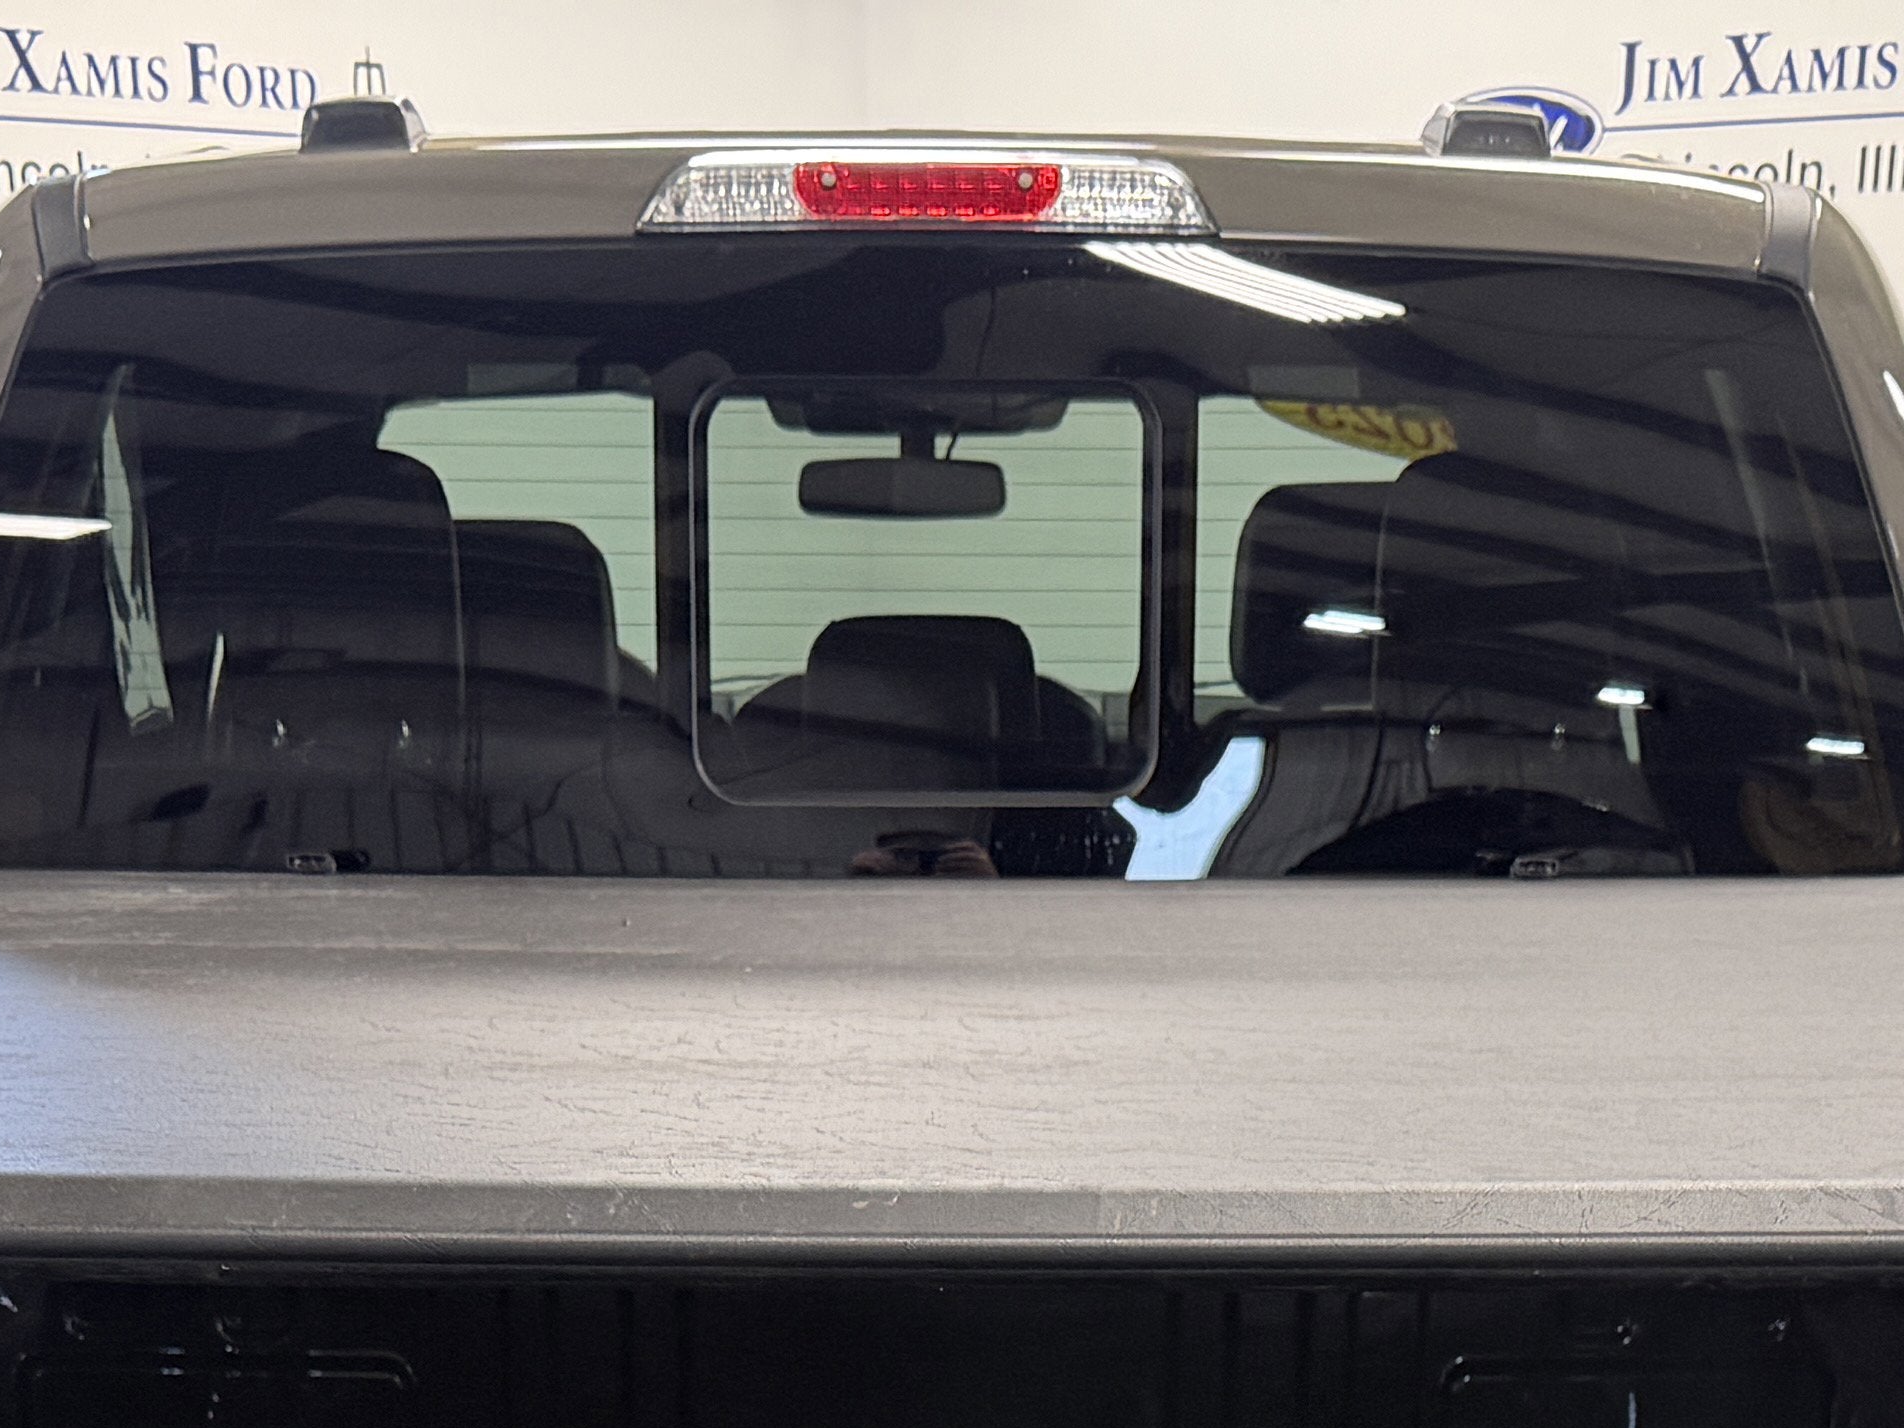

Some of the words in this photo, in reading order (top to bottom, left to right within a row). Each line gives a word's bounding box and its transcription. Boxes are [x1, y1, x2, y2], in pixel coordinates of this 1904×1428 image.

[183, 41, 317, 111] FORD
[1614, 40, 1705, 116] JIM
[1719, 31, 1899, 99] XAMIS
